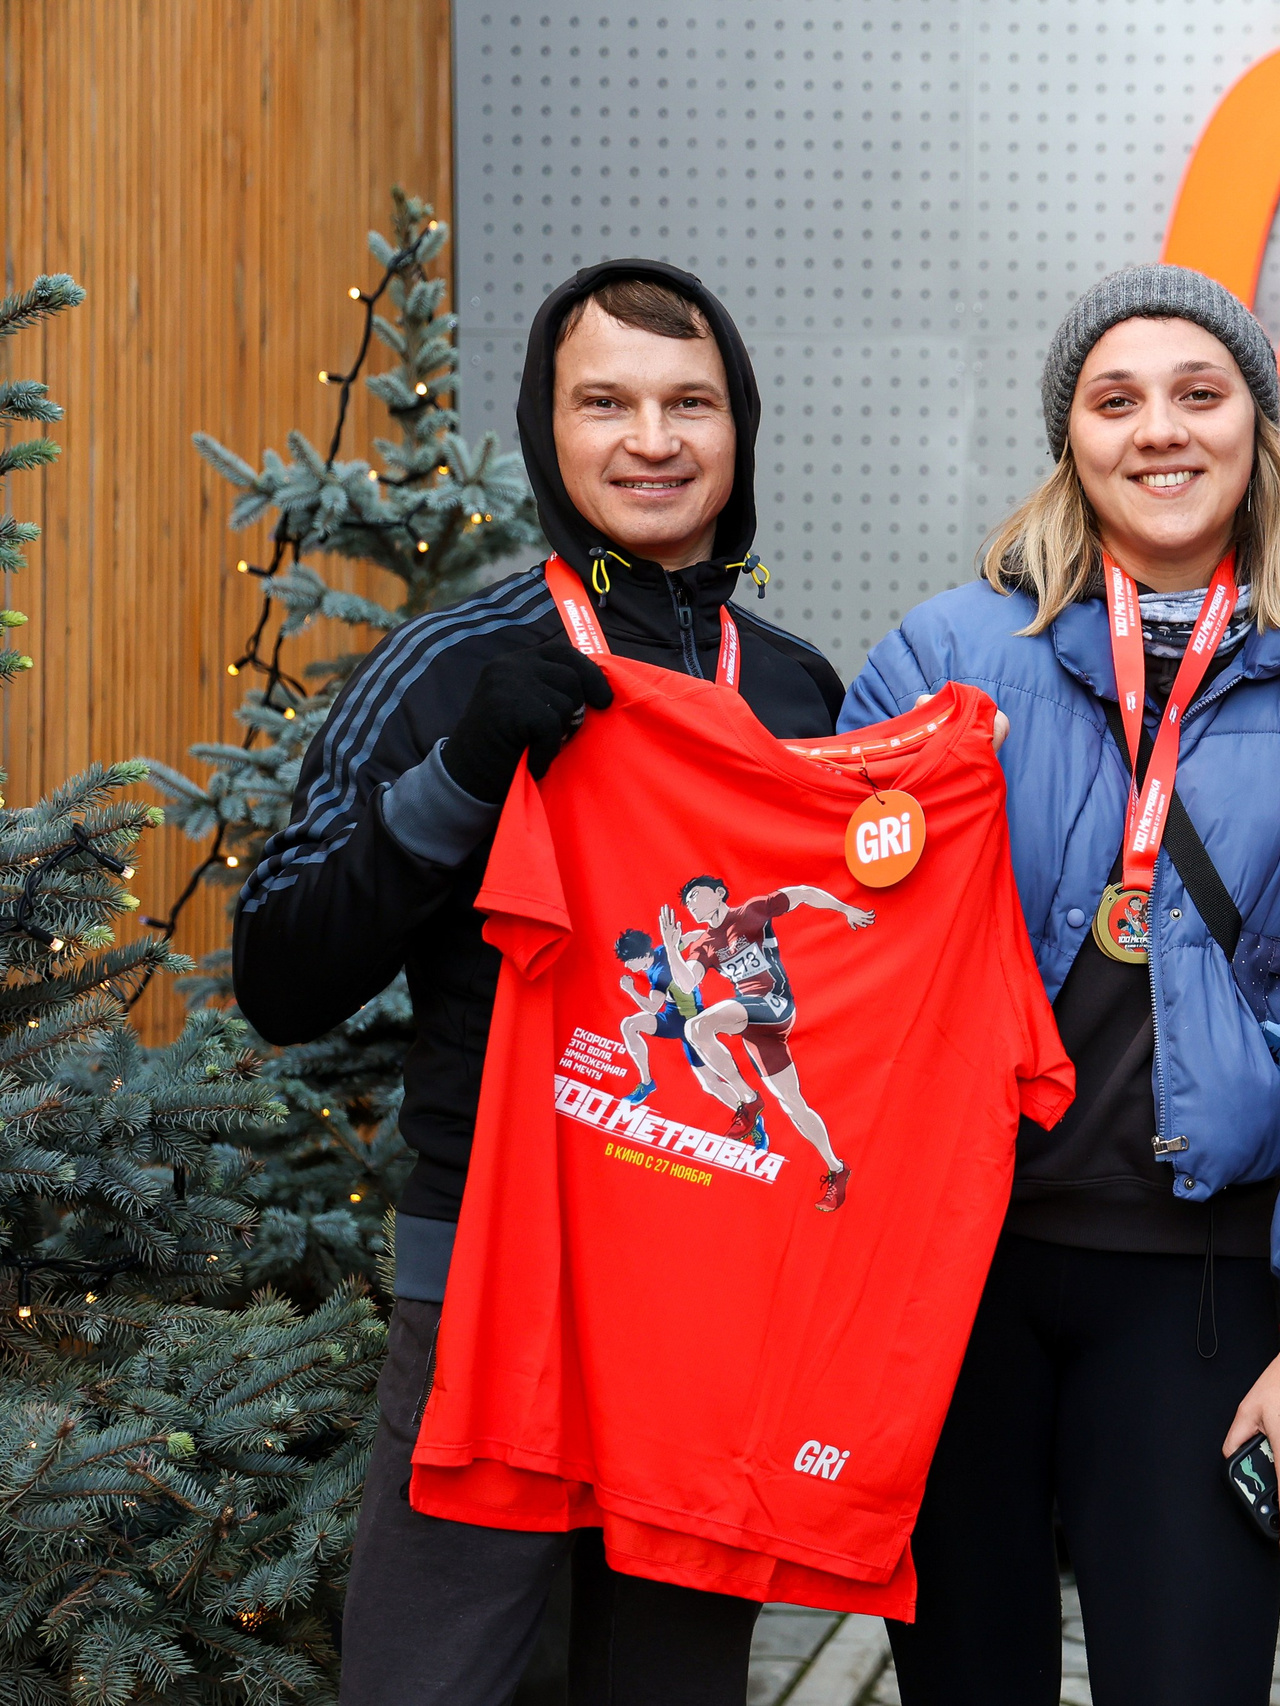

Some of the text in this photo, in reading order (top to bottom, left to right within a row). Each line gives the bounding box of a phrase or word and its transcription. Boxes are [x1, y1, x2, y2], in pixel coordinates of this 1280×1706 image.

[563, 599, 591, 645] МЕТРОВКА
[1111, 566, 1129, 637] 100 МЕТРОВКА
[1192, 584, 1227, 655] 100 МЕТРОВКА
[856, 812, 911, 864] GRi
[1132, 778, 1161, 853] 100 МЕТРОВКА
[727, 952, 760, 976] 273
[564, 1048, 628, 1077] УМНОЖЕННАЯ
[568, 1037, 613, 1062] ЭТО ВОЛЯ,
[573, 1027, 627, 1055] СКОРОСТЬ
[559, 1058, 603, 1081] НА МЕЧТУ
[604, 1098, 787, 1181] МЕТРОВКА
[604, 1142, 713, 1187] В КИНО С 27 НОЯБРЯ
[793, 1440, 851, 1481] GRi
